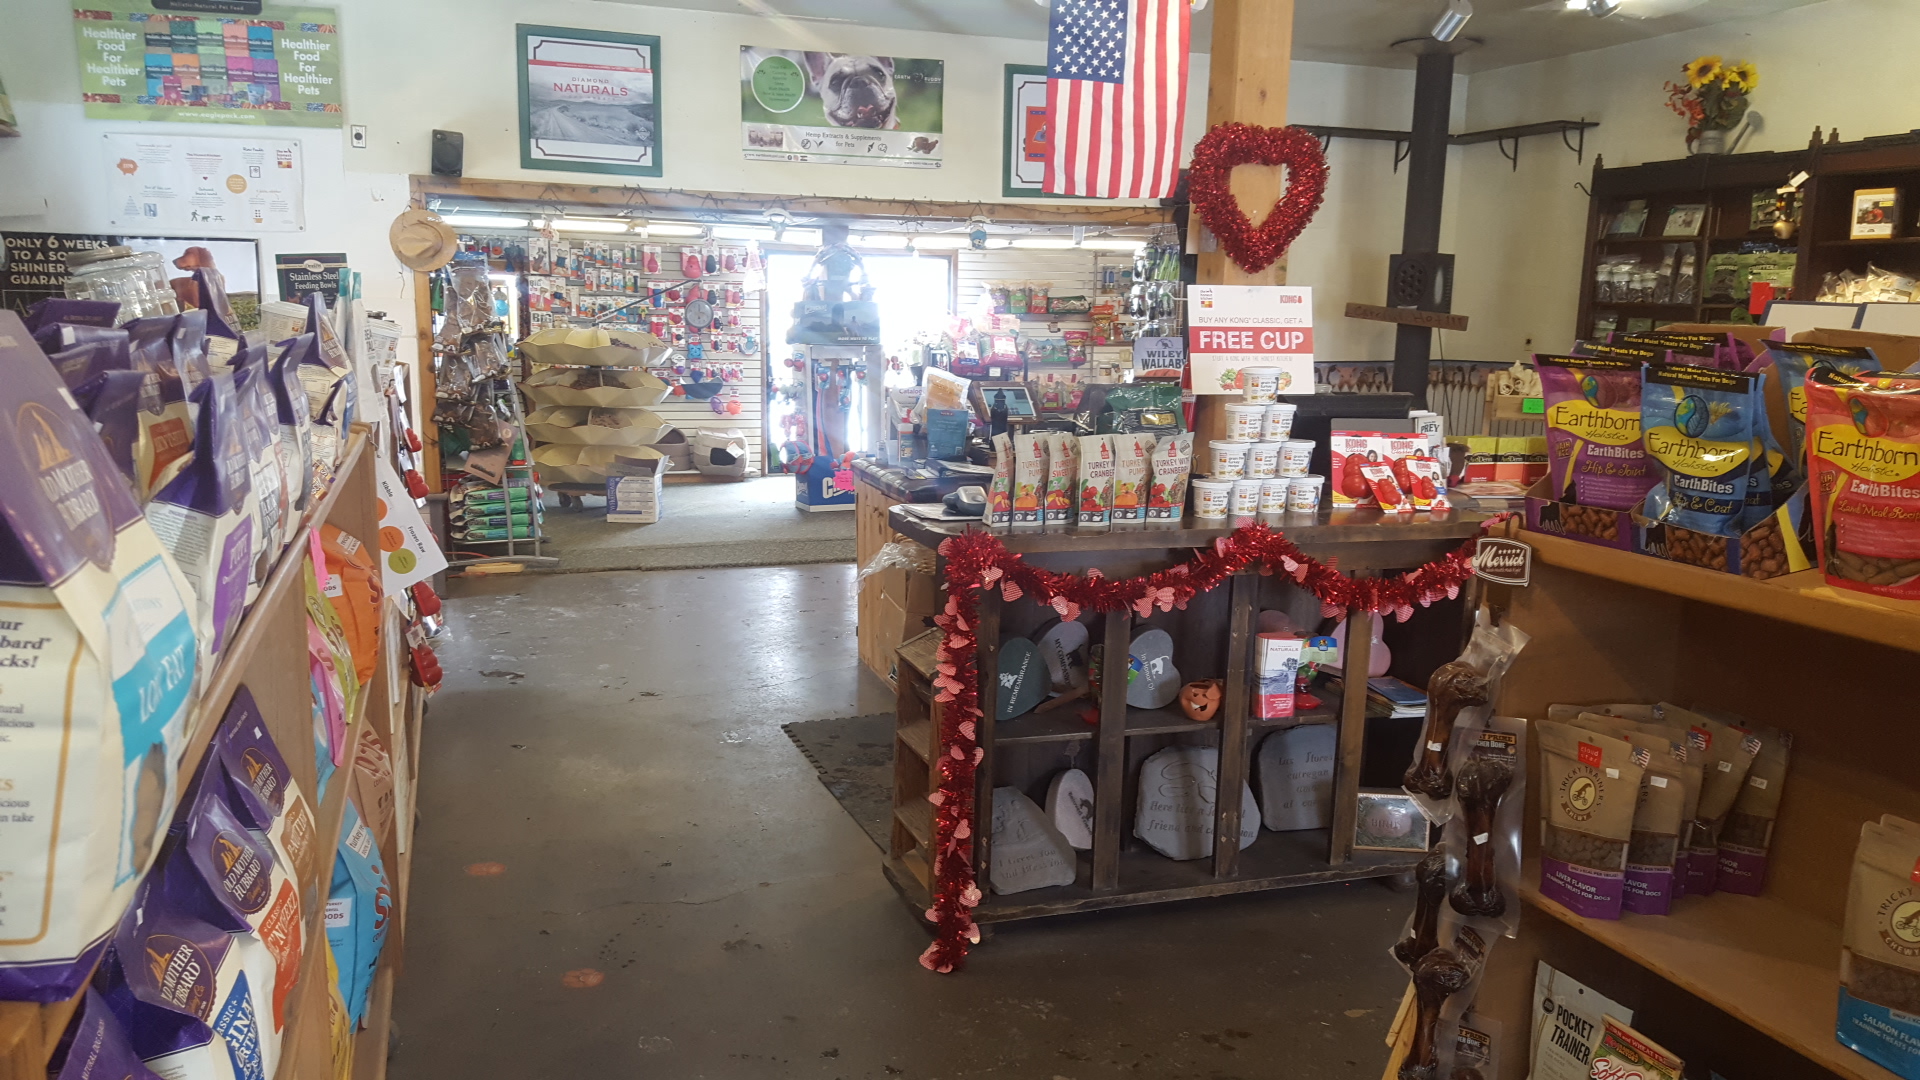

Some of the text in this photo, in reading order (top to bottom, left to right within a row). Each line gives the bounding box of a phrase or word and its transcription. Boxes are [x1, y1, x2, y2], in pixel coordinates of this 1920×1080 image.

[83, 27, 138, 41] Healthier
[97, 40, 127, 52] Food
[281, 38, 332, 52] Healthier
[103, 52, 122, 63] For
[293, 51, 320, 62] Food
[87, 63, 141, 77] Healthier
[299, 62, 317, 73] For
[102, 75, 127, 88] Pets
[283, 72, 334, 86] Healthier
[298, 84, 320, 96] Pets
[553, 82, 629, 97] NATURALS
[805, 131, 821, 139] Hemp
[822, 132, 844, 140] Extracts
[850, 134, 882, 142] Supplements
[5, 235, 110, 250] ONLY 6 WEEKS
[12, 250, 32, 261] TO
[35, 250, 45, 261] A
[10, 263, 64, 274] SHINIER
[10, 274, 70, 286] GUARAN
[289, 270, 339, 282] Stainless Steel
[294, 280, 337, 291] Feeding Bowls
[1280, 295, 1297, 304] KONG
[1198, 316, 1213, 324] BUY
[1214, 316, 1228, 324] ANY
[1199, 331, 1304, 350] FREE CUP
[1624, 336, 1641, 344] Natural
[1689, 342, 1703, 350] Dogs
[1146, 350, 1182, 358] WILEY
[1597, 344, 1610, 352] Moist
[1639, 350, 1654, 358] Dogs
[1693, 374, 1710, 382] Treats
[1722, 377, 1736, 386] Dogs
[899, 388, 923, 397] Catalog
[1555, 405, 1641, 431] Earthborn
[1421, 424, 1440, 433] PREY
[1345, 439, 1367, 449] KONG
[1390, 440, 1414, 450] KONG
[1648, 432, 1734, 463] Earthborn
[1817, 431, 1918, 466] Earthborn
[1587, 444, 1645, 459] EarthBites
[1088, 460, 1110, 470] TURKEY
[1155, 458, 1178, 468] TURKEY
[1416, 462, 1431, 470] KONG
[1581, 460, 1647, 478] Hip & Joint
[382, 480, 393, 498] Kibble
[1673, 474, 1734, 495] EarthBites
[1850, 479, 1920, 499] EarthBites
[1704, 498, 1733, 514] Coat
[1839, 500, 1920, 523] Land Meal Recip
[407, 525, 427, 554] Frozen Raw
[1472, 545, 1525, 569] Merrick
[1054, 637, 1063, 650] MY
[160, 643, 188, 694] FAT
[1009, 651, 1032, 705] REMEMBRANCE
[1488, 734, 1513, 743] PRIME
[1580, 746, 1599, 757] cloud
[1559, 766, 1582, 792] TRICKY
[1584, 766, 1605, 807] TRAINERS
[1150, 800, 1173, 812] Here
[11, 812, 34, 823] take
[1565, 806, 1587, 821] CHEWY
[1147, 819, 1180, 831] friend
[349, 830, 364, 850] turkey
[223, 845, 255, 894] OLD MOTHER
[233, 858, 261, 902] HUBBARD
[1555, 871, 1597, 893] LIVER FLAVOR
[1546, 873, 1611, 902] TRAINING TREATS FOR DOGS
[1632, 888, 1644, 896] FOR
[1877, 887, 1914, 917] TRICKY
[1885, 937, 1920, 957] CHEWY
[165, 943, 195, 988] MOTHER
[1556, 1003, 1595, 1042] POCKET
[1862, 1013, 1900, 1038] SALMON
[1852, 1016, 1907, 1052] TRAINING TREATS
[1550, 1024, 1591, 1066] TRAINER
[1621, 1034, 1654, 1057] and WHEAT
[1591, 1057, 1627, 1080] Soft
